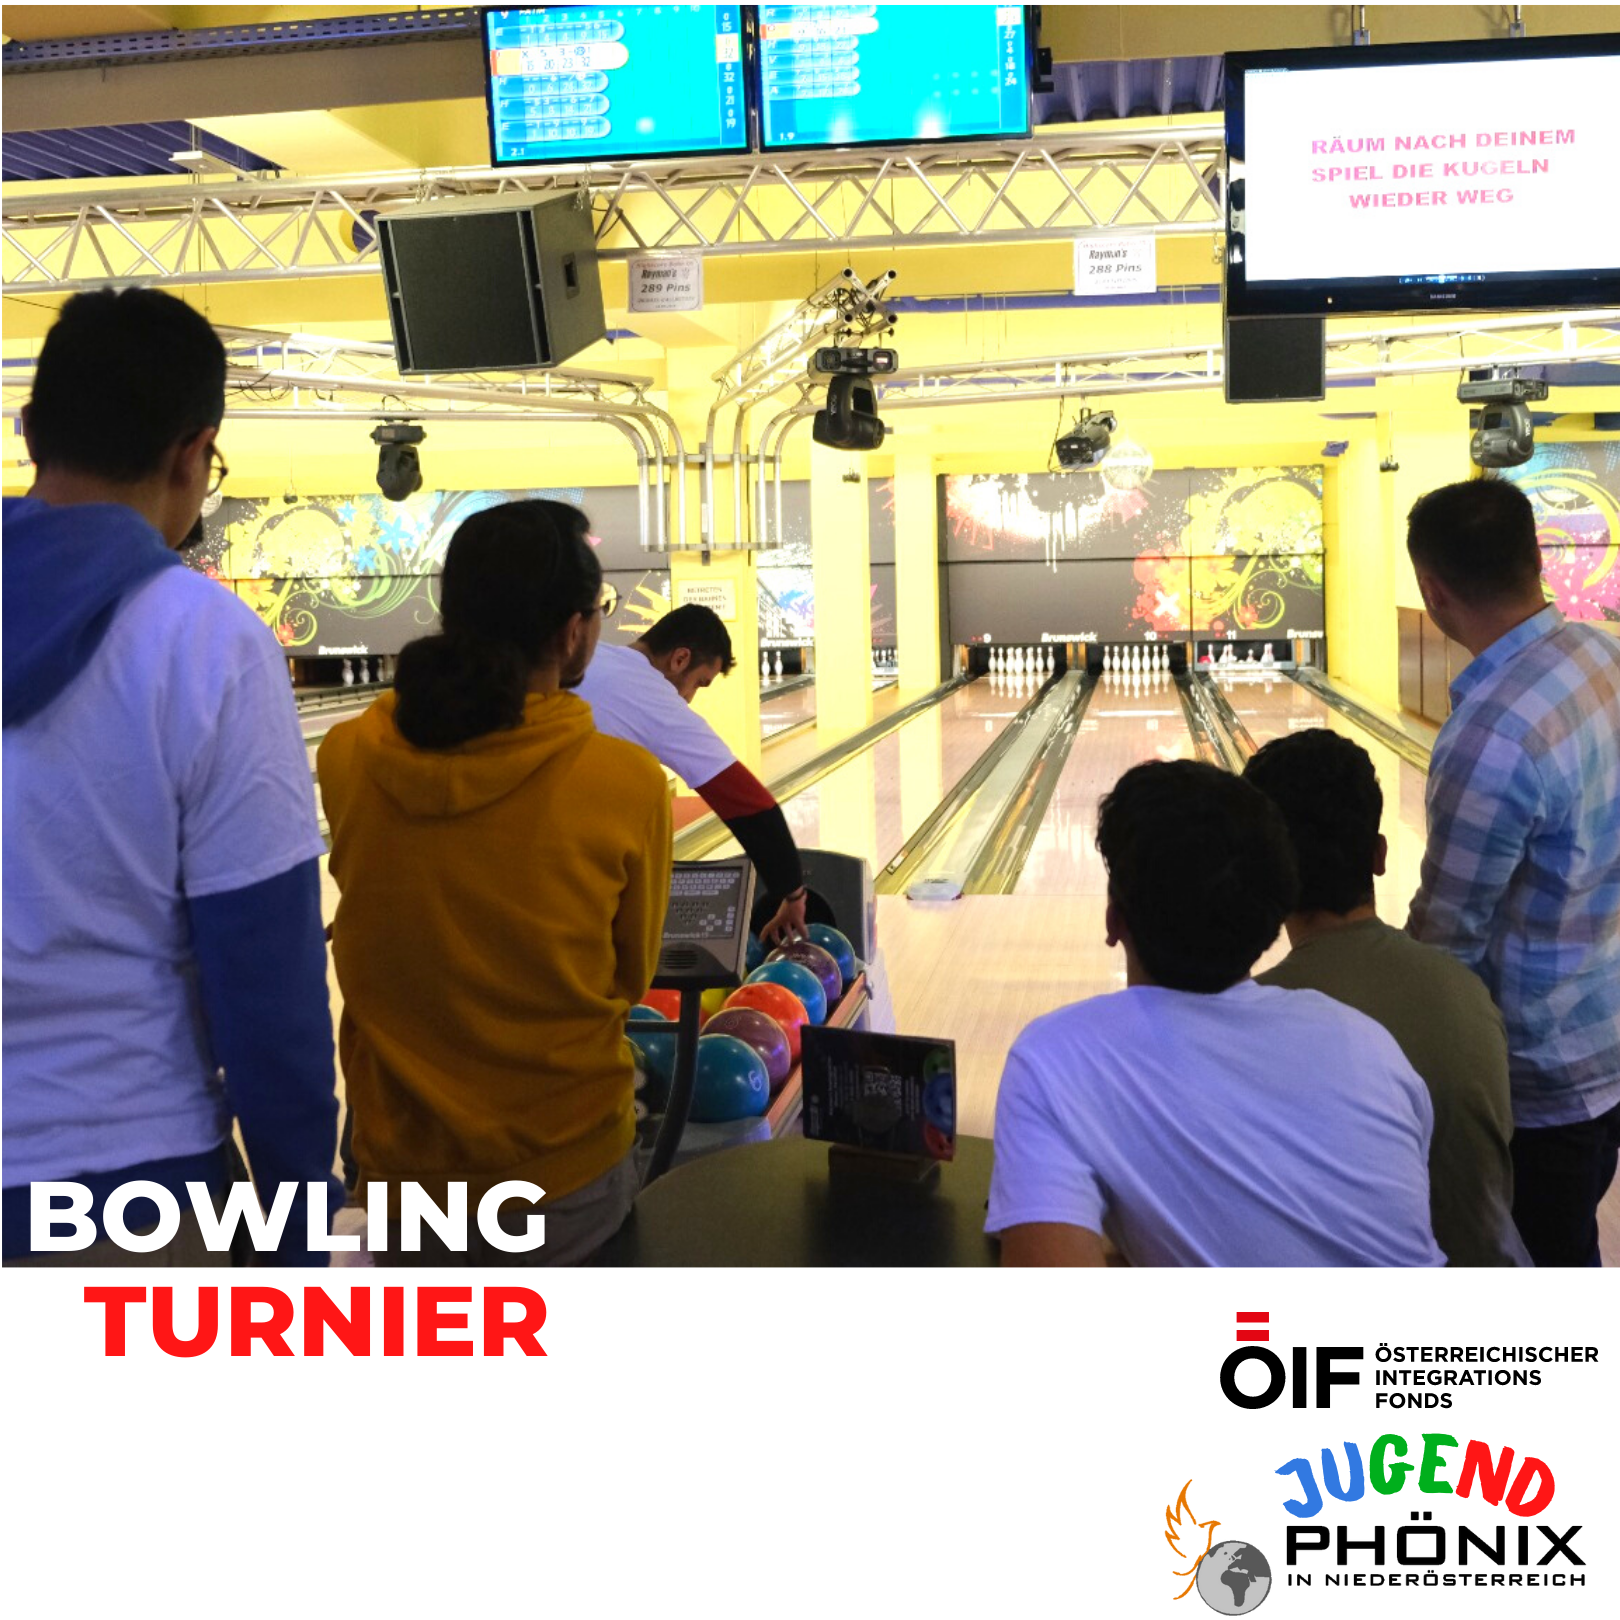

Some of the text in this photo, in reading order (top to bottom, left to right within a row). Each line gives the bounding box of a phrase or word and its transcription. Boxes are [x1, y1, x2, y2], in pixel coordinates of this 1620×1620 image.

[1311, 129, 1576, 154] RÄUM NACH DEINEM
[510, 148, 525, 156] 2.1
[1311, 159, 1549, 182] SPIEL DIE KUGELN
[1348, 188, 1514, 208] WIEDER WEG
[1089, 262, 1142, 275] 288 Pins
[641, 282, 691, 293] 289 Pins
[984, 633, 992, 643] 9
[1040, 631, 1098, 643] Brunswick
[1144, 632, 1157, 641] 10
[1226, 630, 1237, 640] 11
